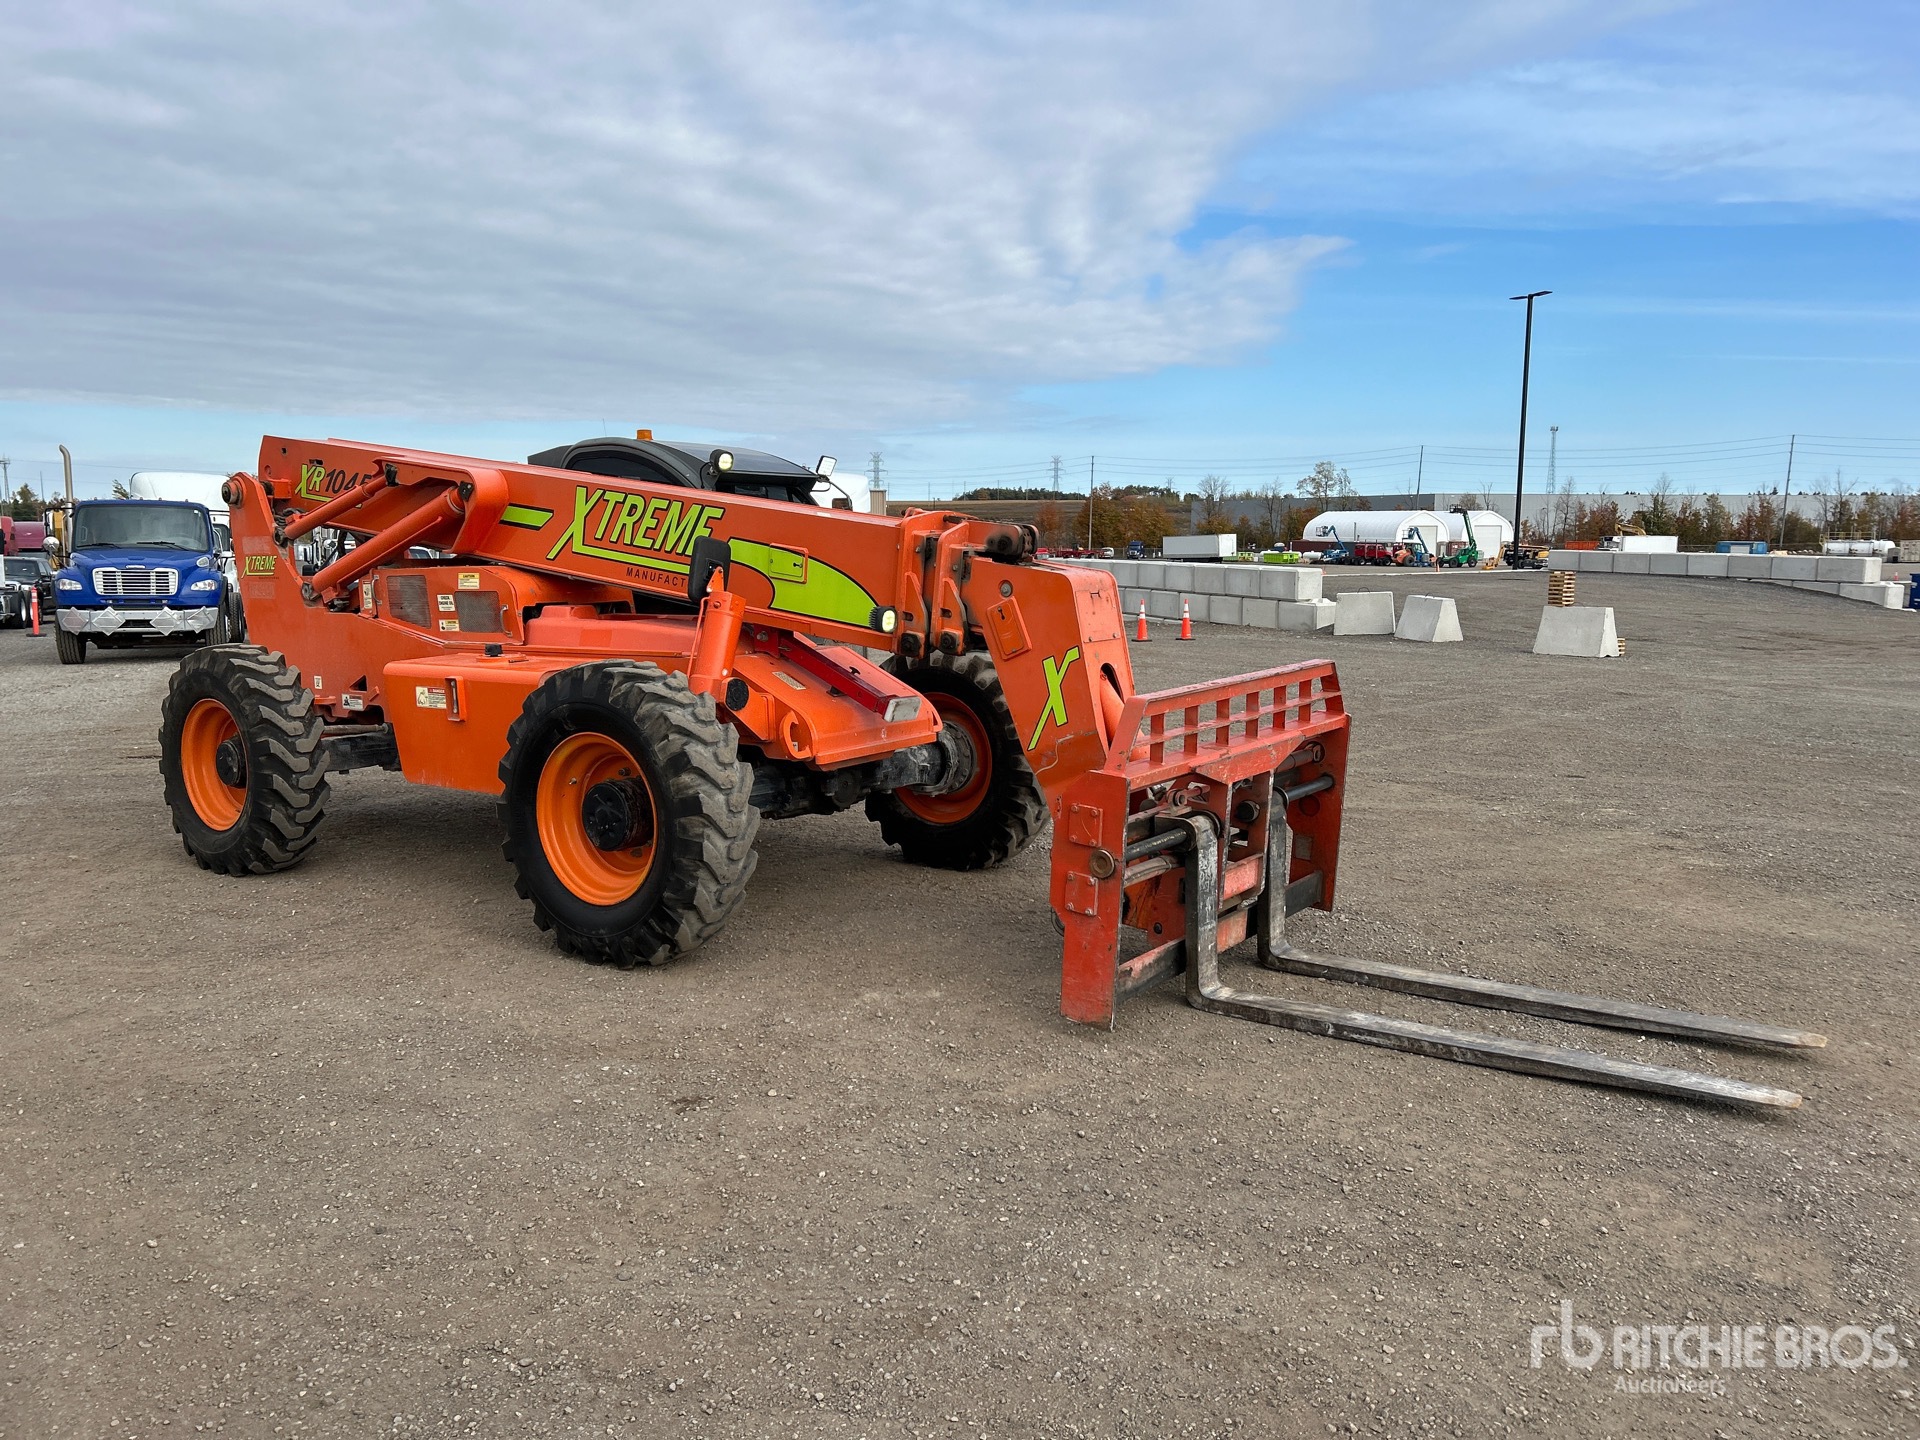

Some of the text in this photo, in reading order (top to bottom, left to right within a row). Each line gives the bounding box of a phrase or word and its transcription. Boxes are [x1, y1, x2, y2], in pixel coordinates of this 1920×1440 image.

[546, 485, 725, 565] XTREME
[241, 555, 277, 579] XTREME
[1027, 645, 1080, 751] X
